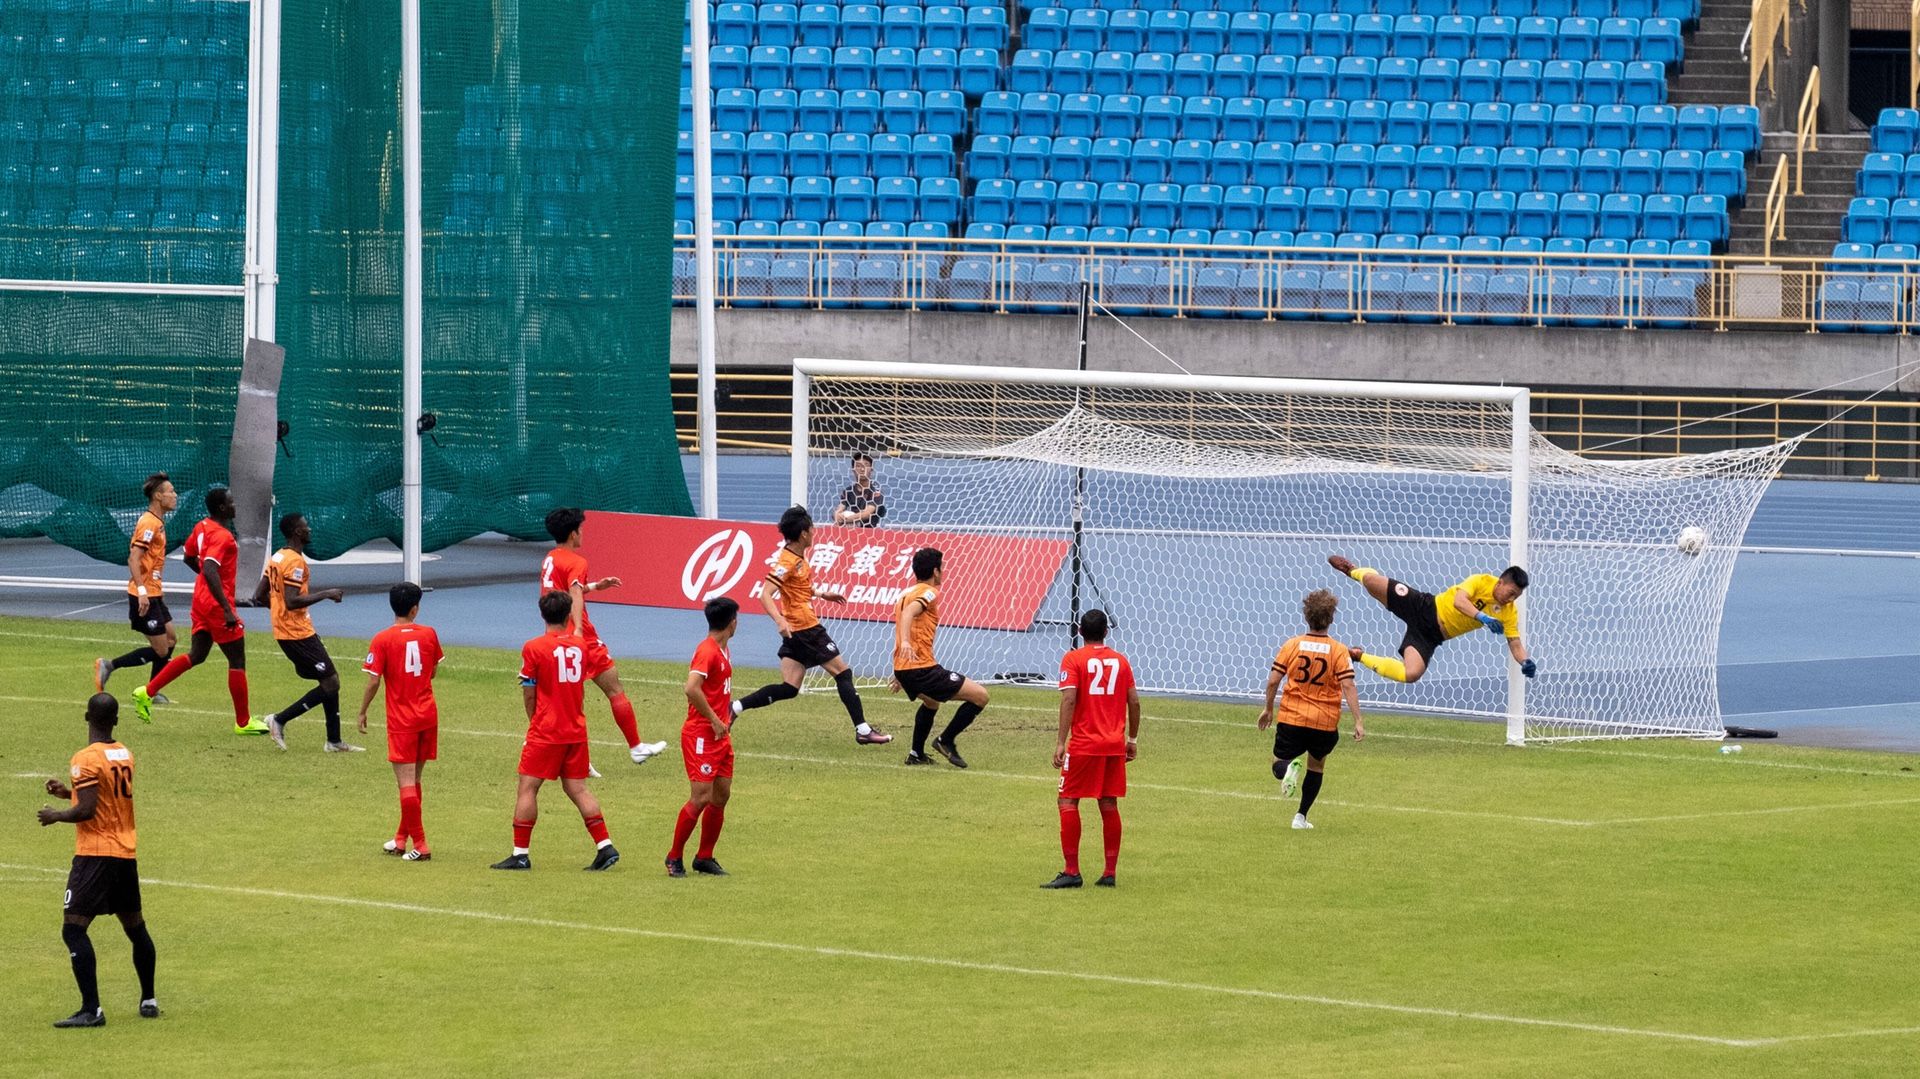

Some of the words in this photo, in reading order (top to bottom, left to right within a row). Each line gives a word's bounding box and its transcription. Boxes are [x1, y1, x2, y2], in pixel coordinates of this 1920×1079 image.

[542, 556, 554, 588] 2
[405, 640, 423, 677] 4
[553, 646, 583, 683] 13
[1294, 655, 1328, 686] 32
[1087, 658, 1119, 695] 27
[111, 766, 132, 799] 10
